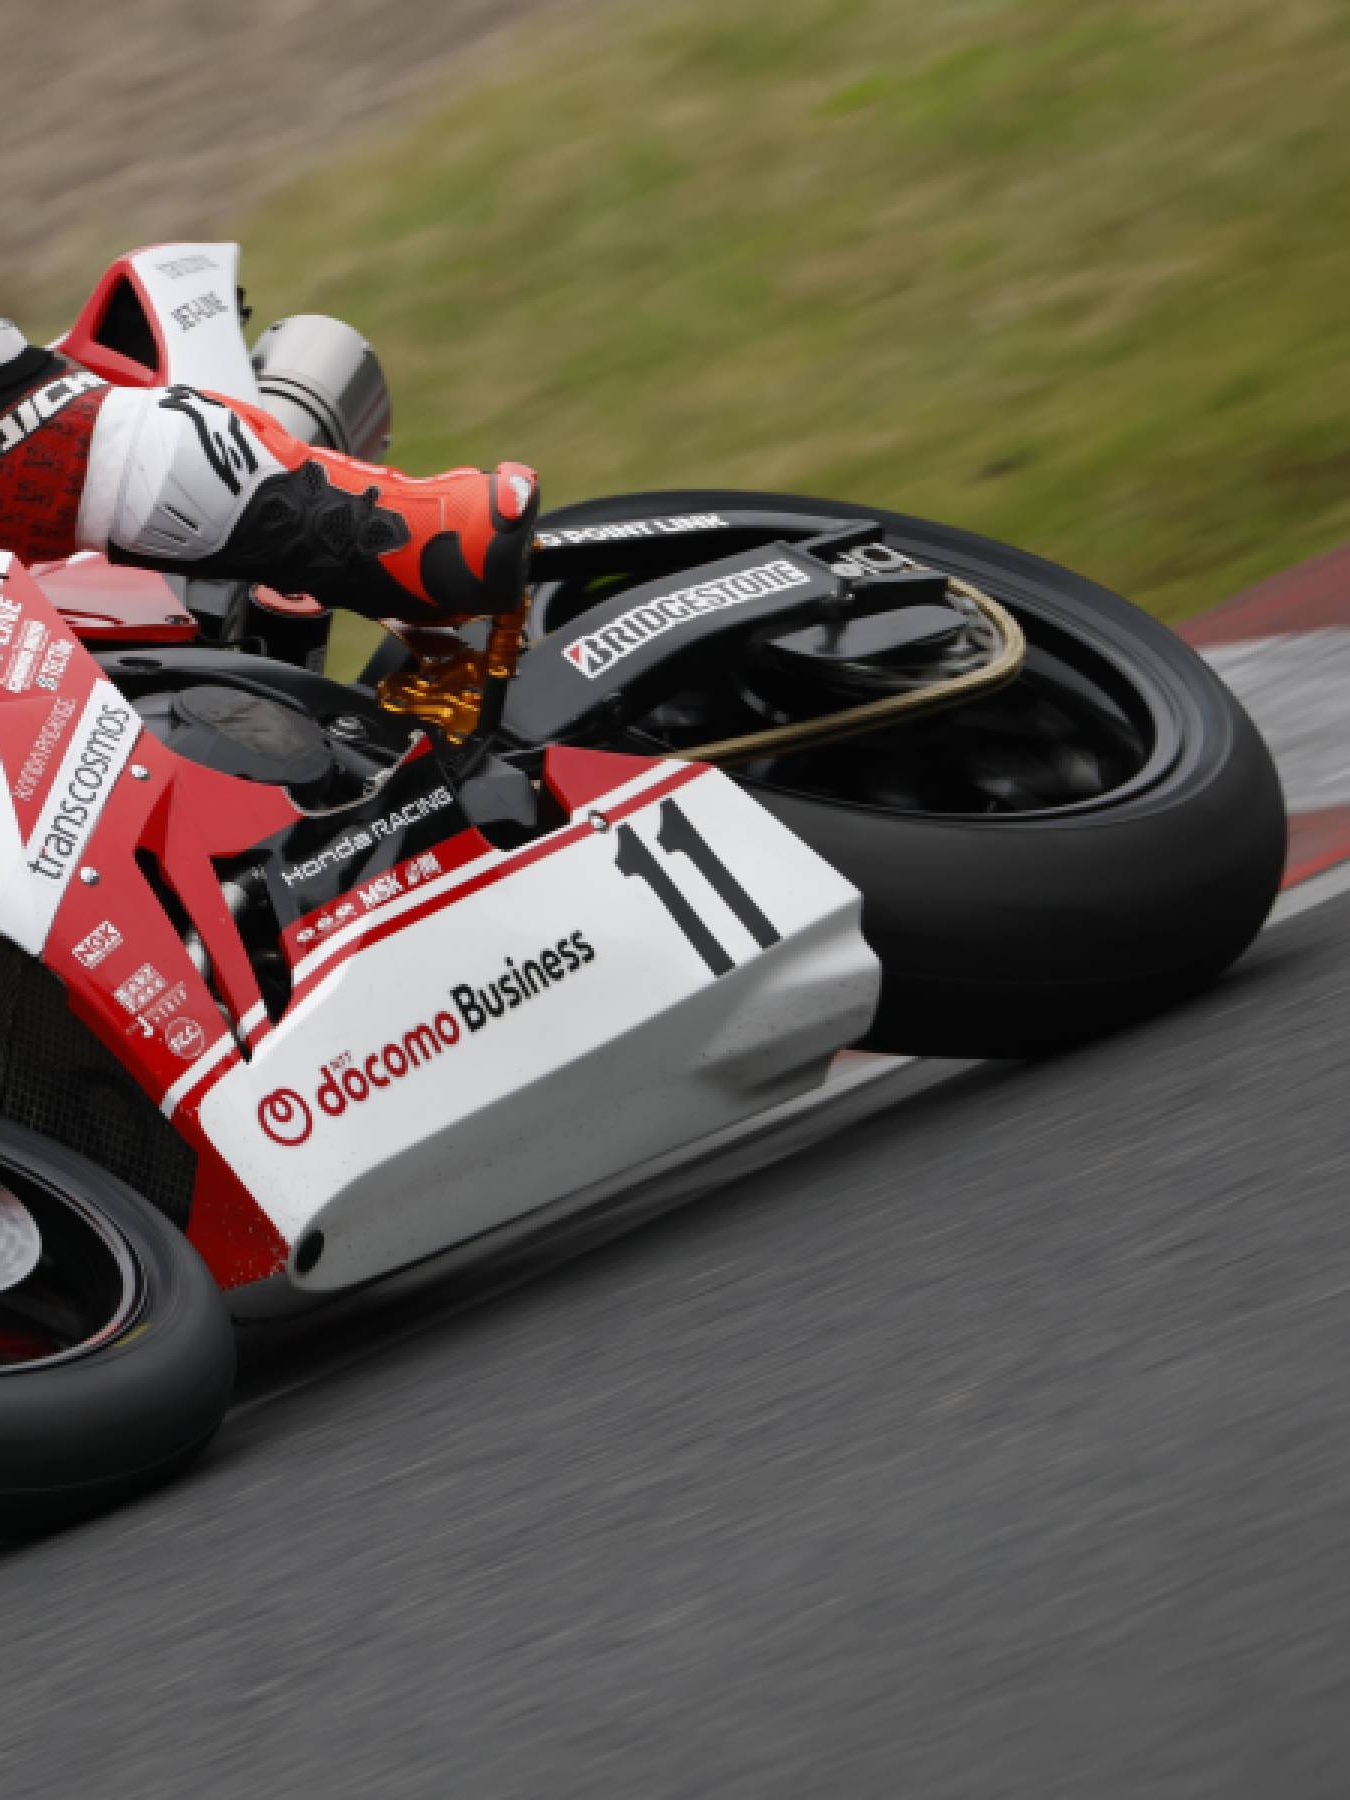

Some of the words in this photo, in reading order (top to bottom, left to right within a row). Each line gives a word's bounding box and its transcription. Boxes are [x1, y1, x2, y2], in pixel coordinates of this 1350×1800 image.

[561, 520, 654, 544] POINT
[652, 512, 730, 533] LINK
[562, 560, 810, 680] BRIDGESTONE
[27, 703, 131, 879] transcosmos
[281, 832, 372, 888] Honda
[370, 786, 453, 840] RACING
[614, 797, 783, 978] 11
[317, 1011, 461, 1117] docomo
[449, 929, 596, 1032] Business
